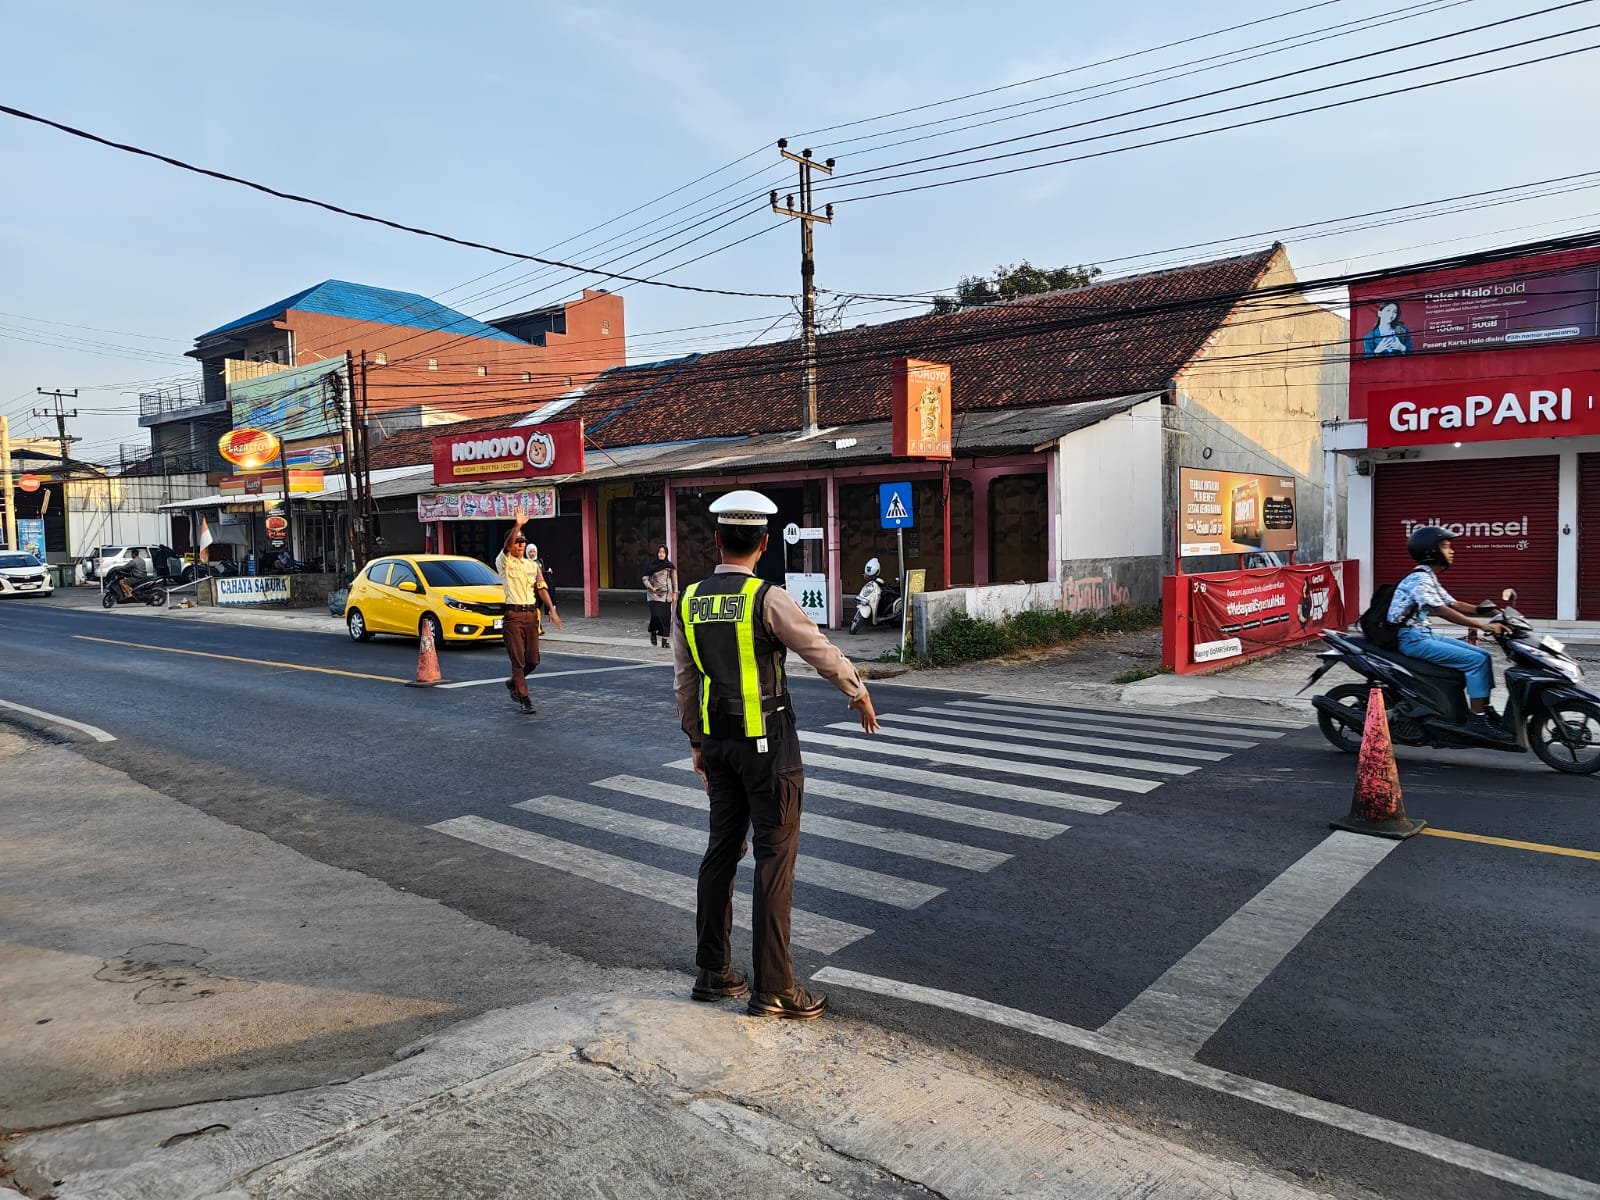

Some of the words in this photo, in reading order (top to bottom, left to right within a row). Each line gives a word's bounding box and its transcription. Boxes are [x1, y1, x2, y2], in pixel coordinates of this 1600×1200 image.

[1494, 282, 1526, 295] bold
[1448, 338, 1467, 346] Kartu
[1468, 336, 1484, 345] Halo
[1389, 387, 1572, 432] GraPARI
[451, 435, 525, 462] MOMOYO
[220, 579, 252, 594] CAHAYA
[254, 577, 287, 593] SAKURA
[688, 595, 745, 623] POLISI
